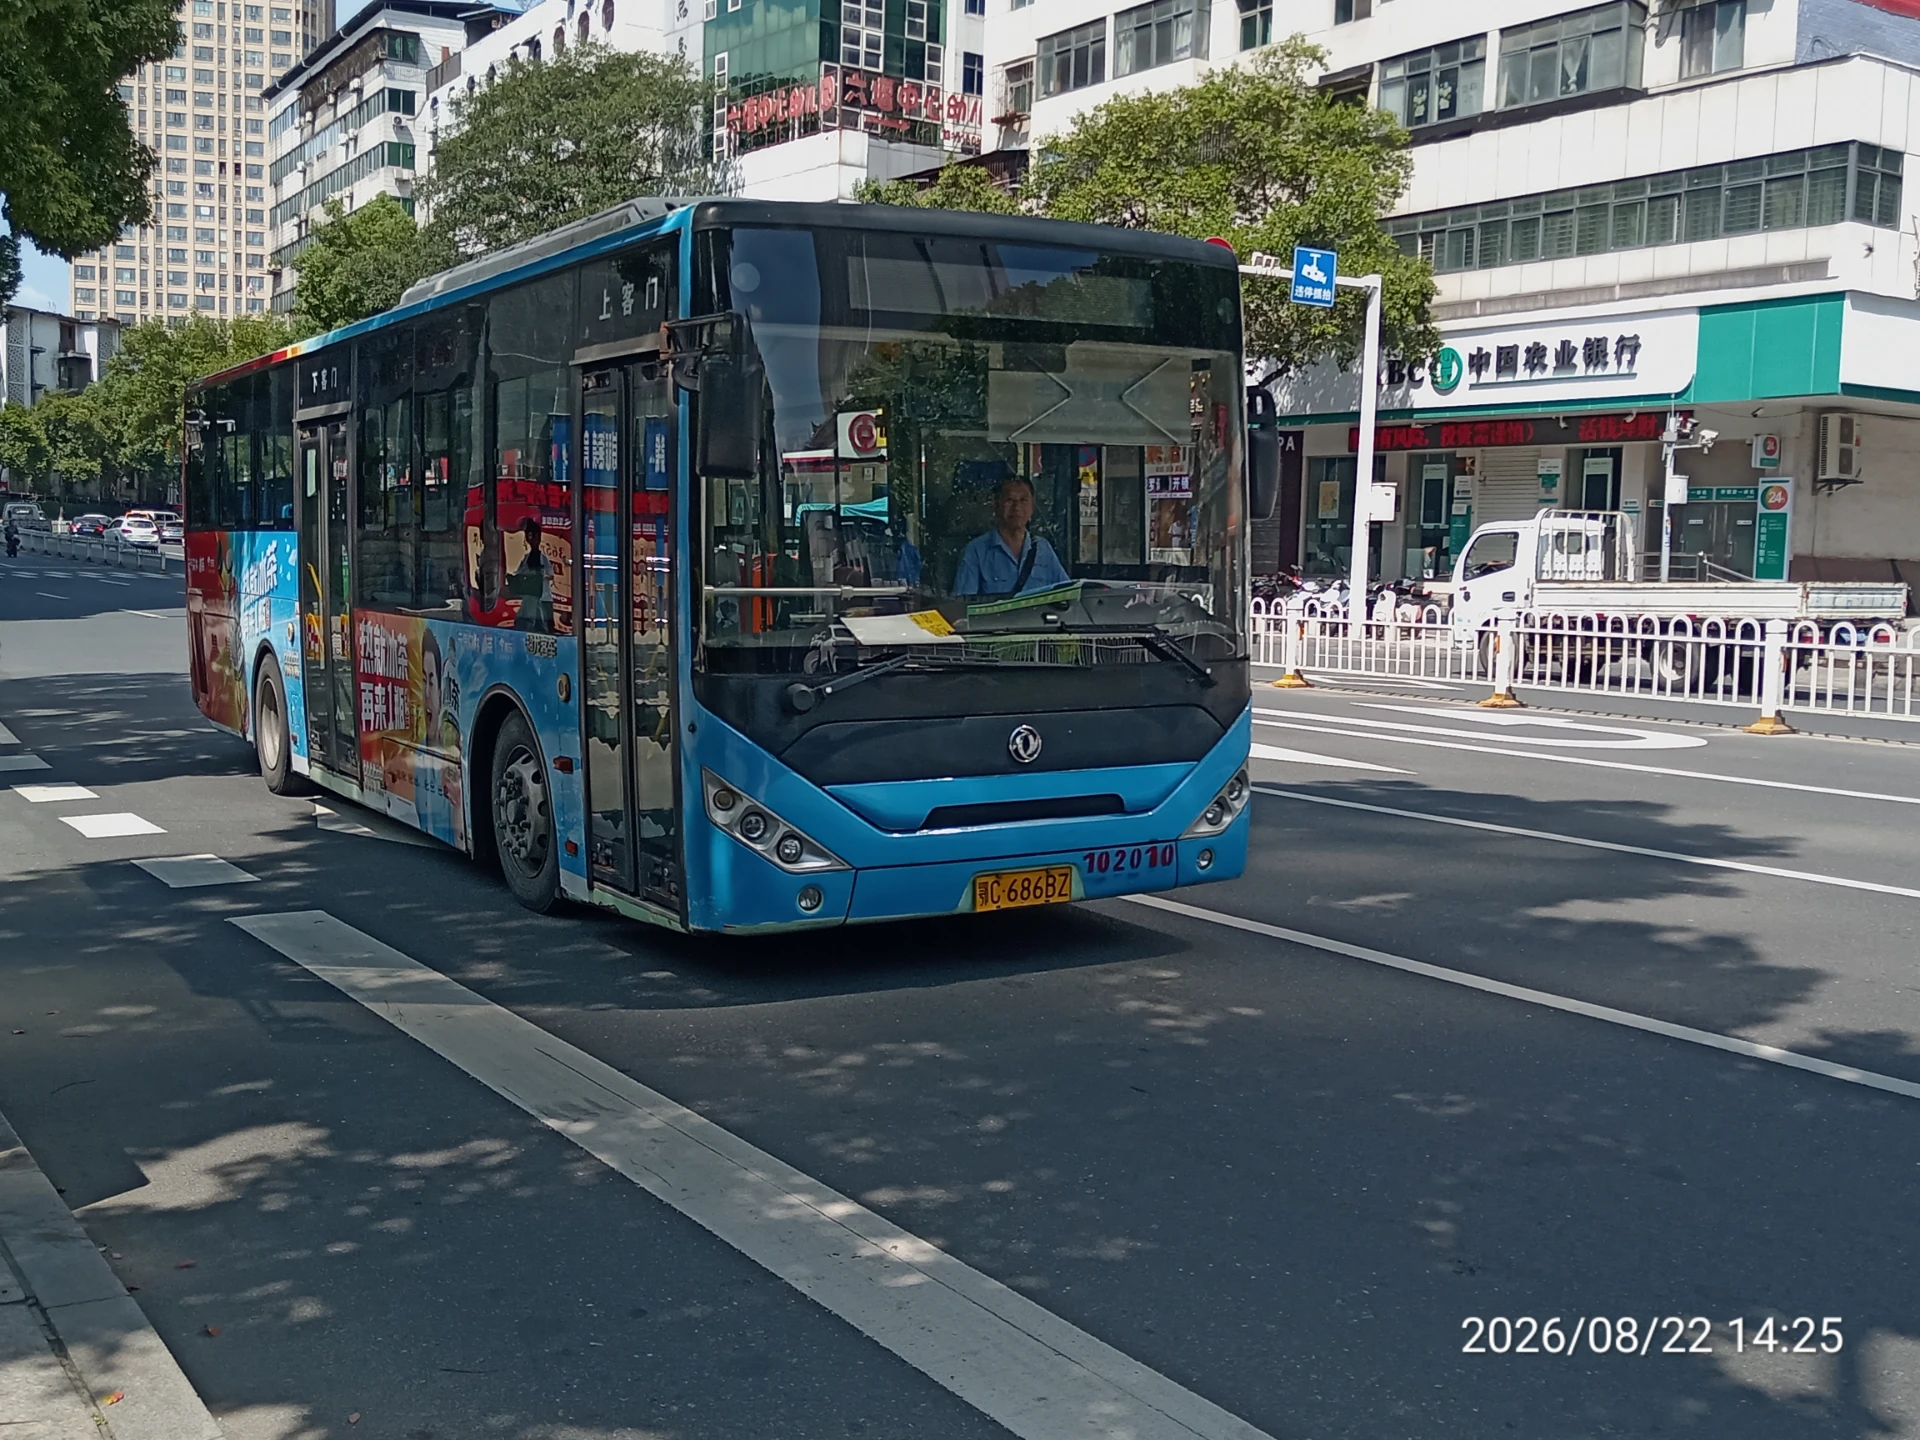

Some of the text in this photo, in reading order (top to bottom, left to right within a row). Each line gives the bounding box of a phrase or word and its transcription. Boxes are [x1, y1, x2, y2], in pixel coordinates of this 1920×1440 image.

[599, 276, 658, 320] 上客门
[1294, 285, 1332, 301] 违停抓拍
[1377, 358, 1425, 386] BC
[1467, 334, 1642, 382] 中国农业银行
[312, 367, 337, 393] 下客门
[359, 617, 408, 681] 热就冰茶
[360, 681, 405, 732] 再来1瓶
[1083, 843, 1174, 874] 102010
